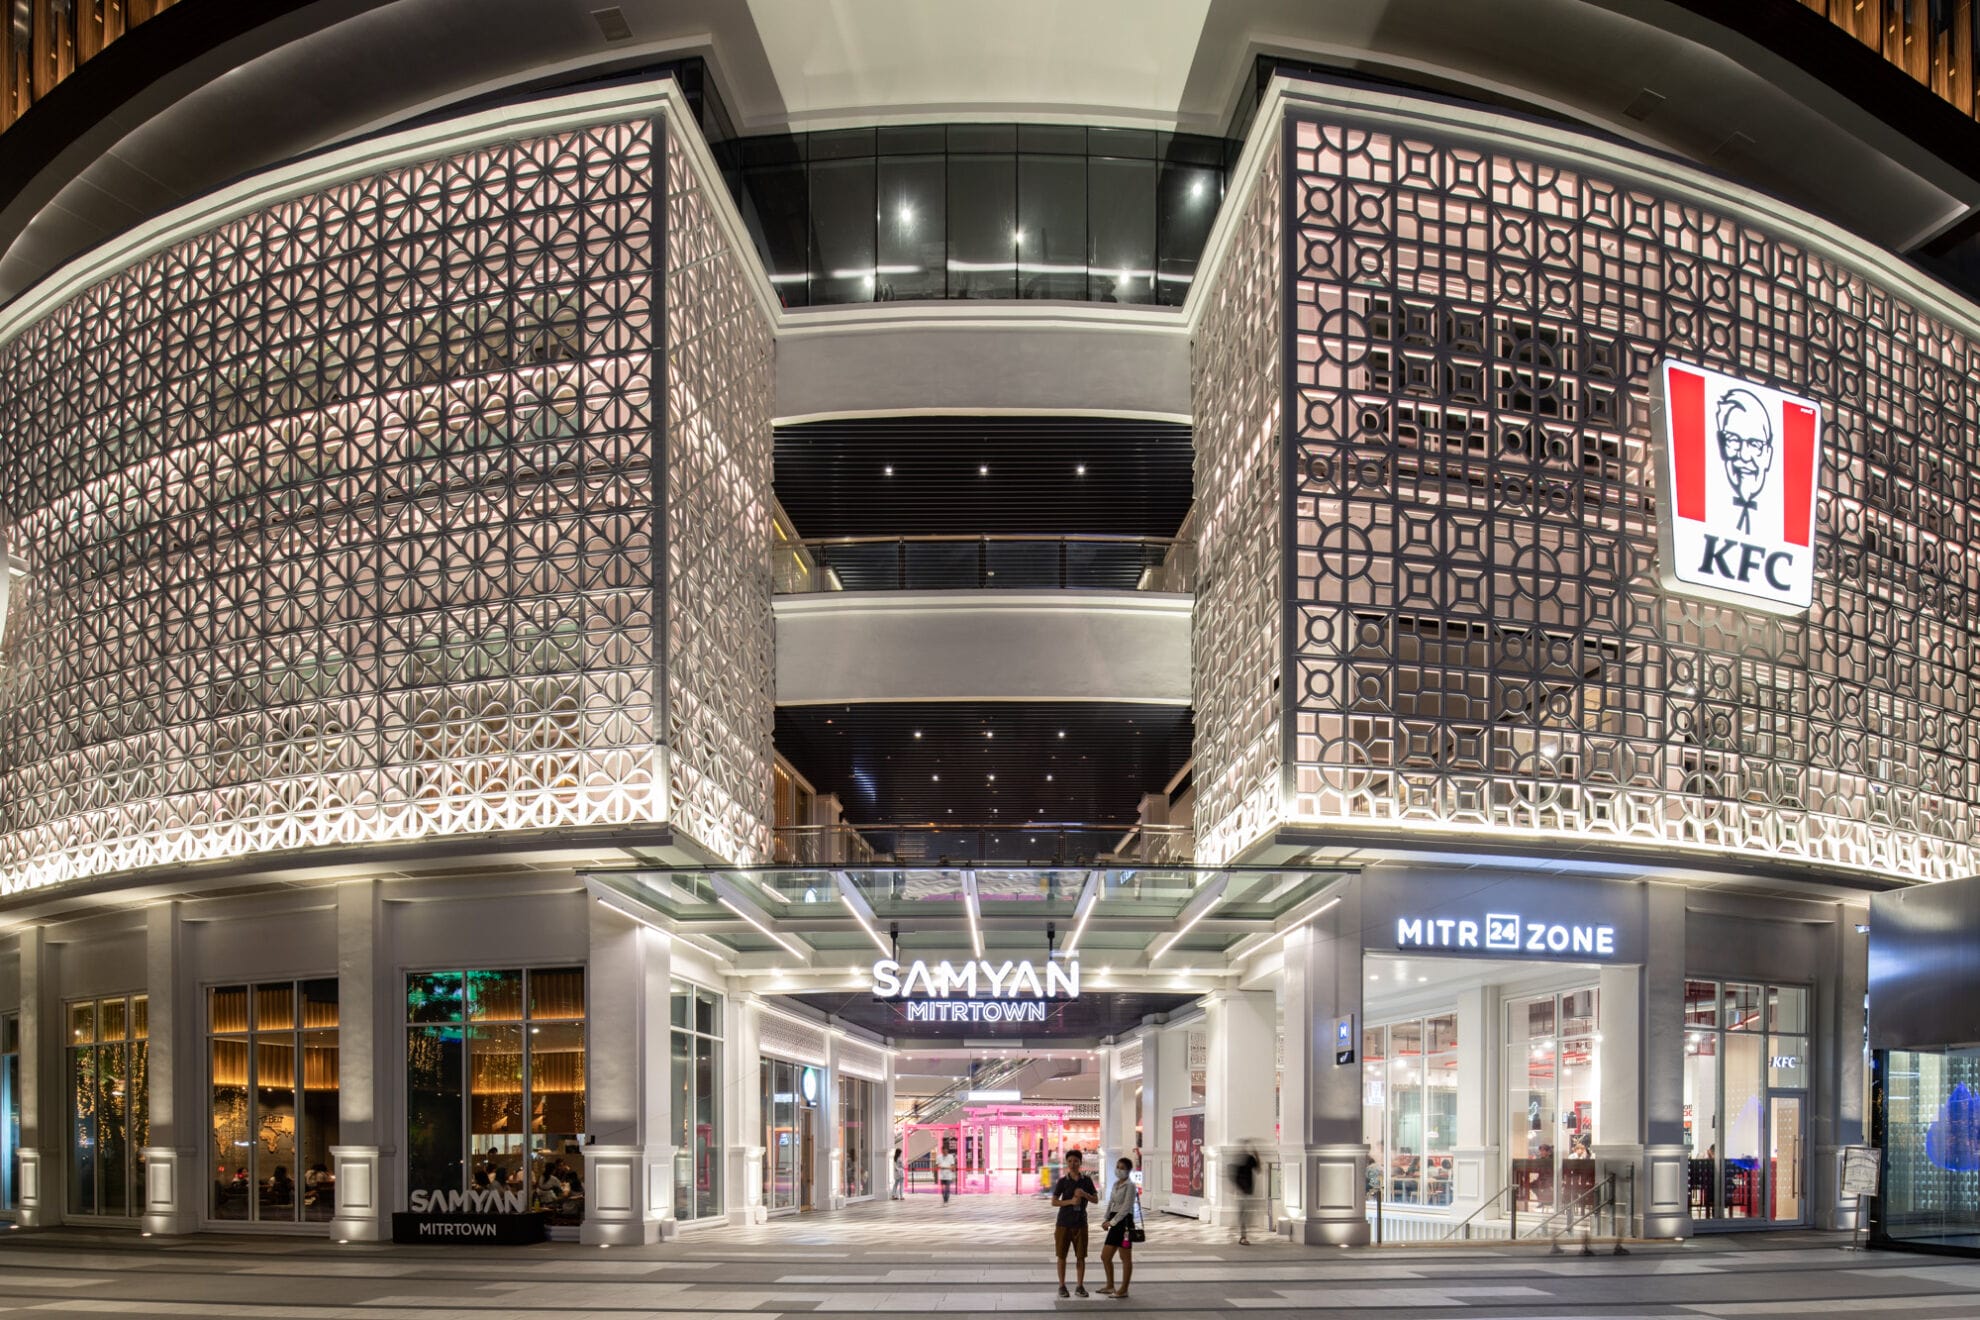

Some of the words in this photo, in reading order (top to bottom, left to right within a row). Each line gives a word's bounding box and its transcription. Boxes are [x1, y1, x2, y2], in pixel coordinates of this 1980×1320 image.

[1698, 533, 1793, 592] KFC
[1398, 918, 1479, 947] MITR
[1490, 922, 1516, 941] 24
[1526, 923, 1615, 953] ZONE
[872, 960, 1080, 997] SAMYAN
[907, 1001, 1046, 1022] MITRTOWN
[1772, 1056, 1797, 1068] KFC
[1175, 1139, 1188, 1153] NOW
[410, 1189, 525, 1213] SAMYAN
[419, 1222, 497, 1236] MITRTOWN
